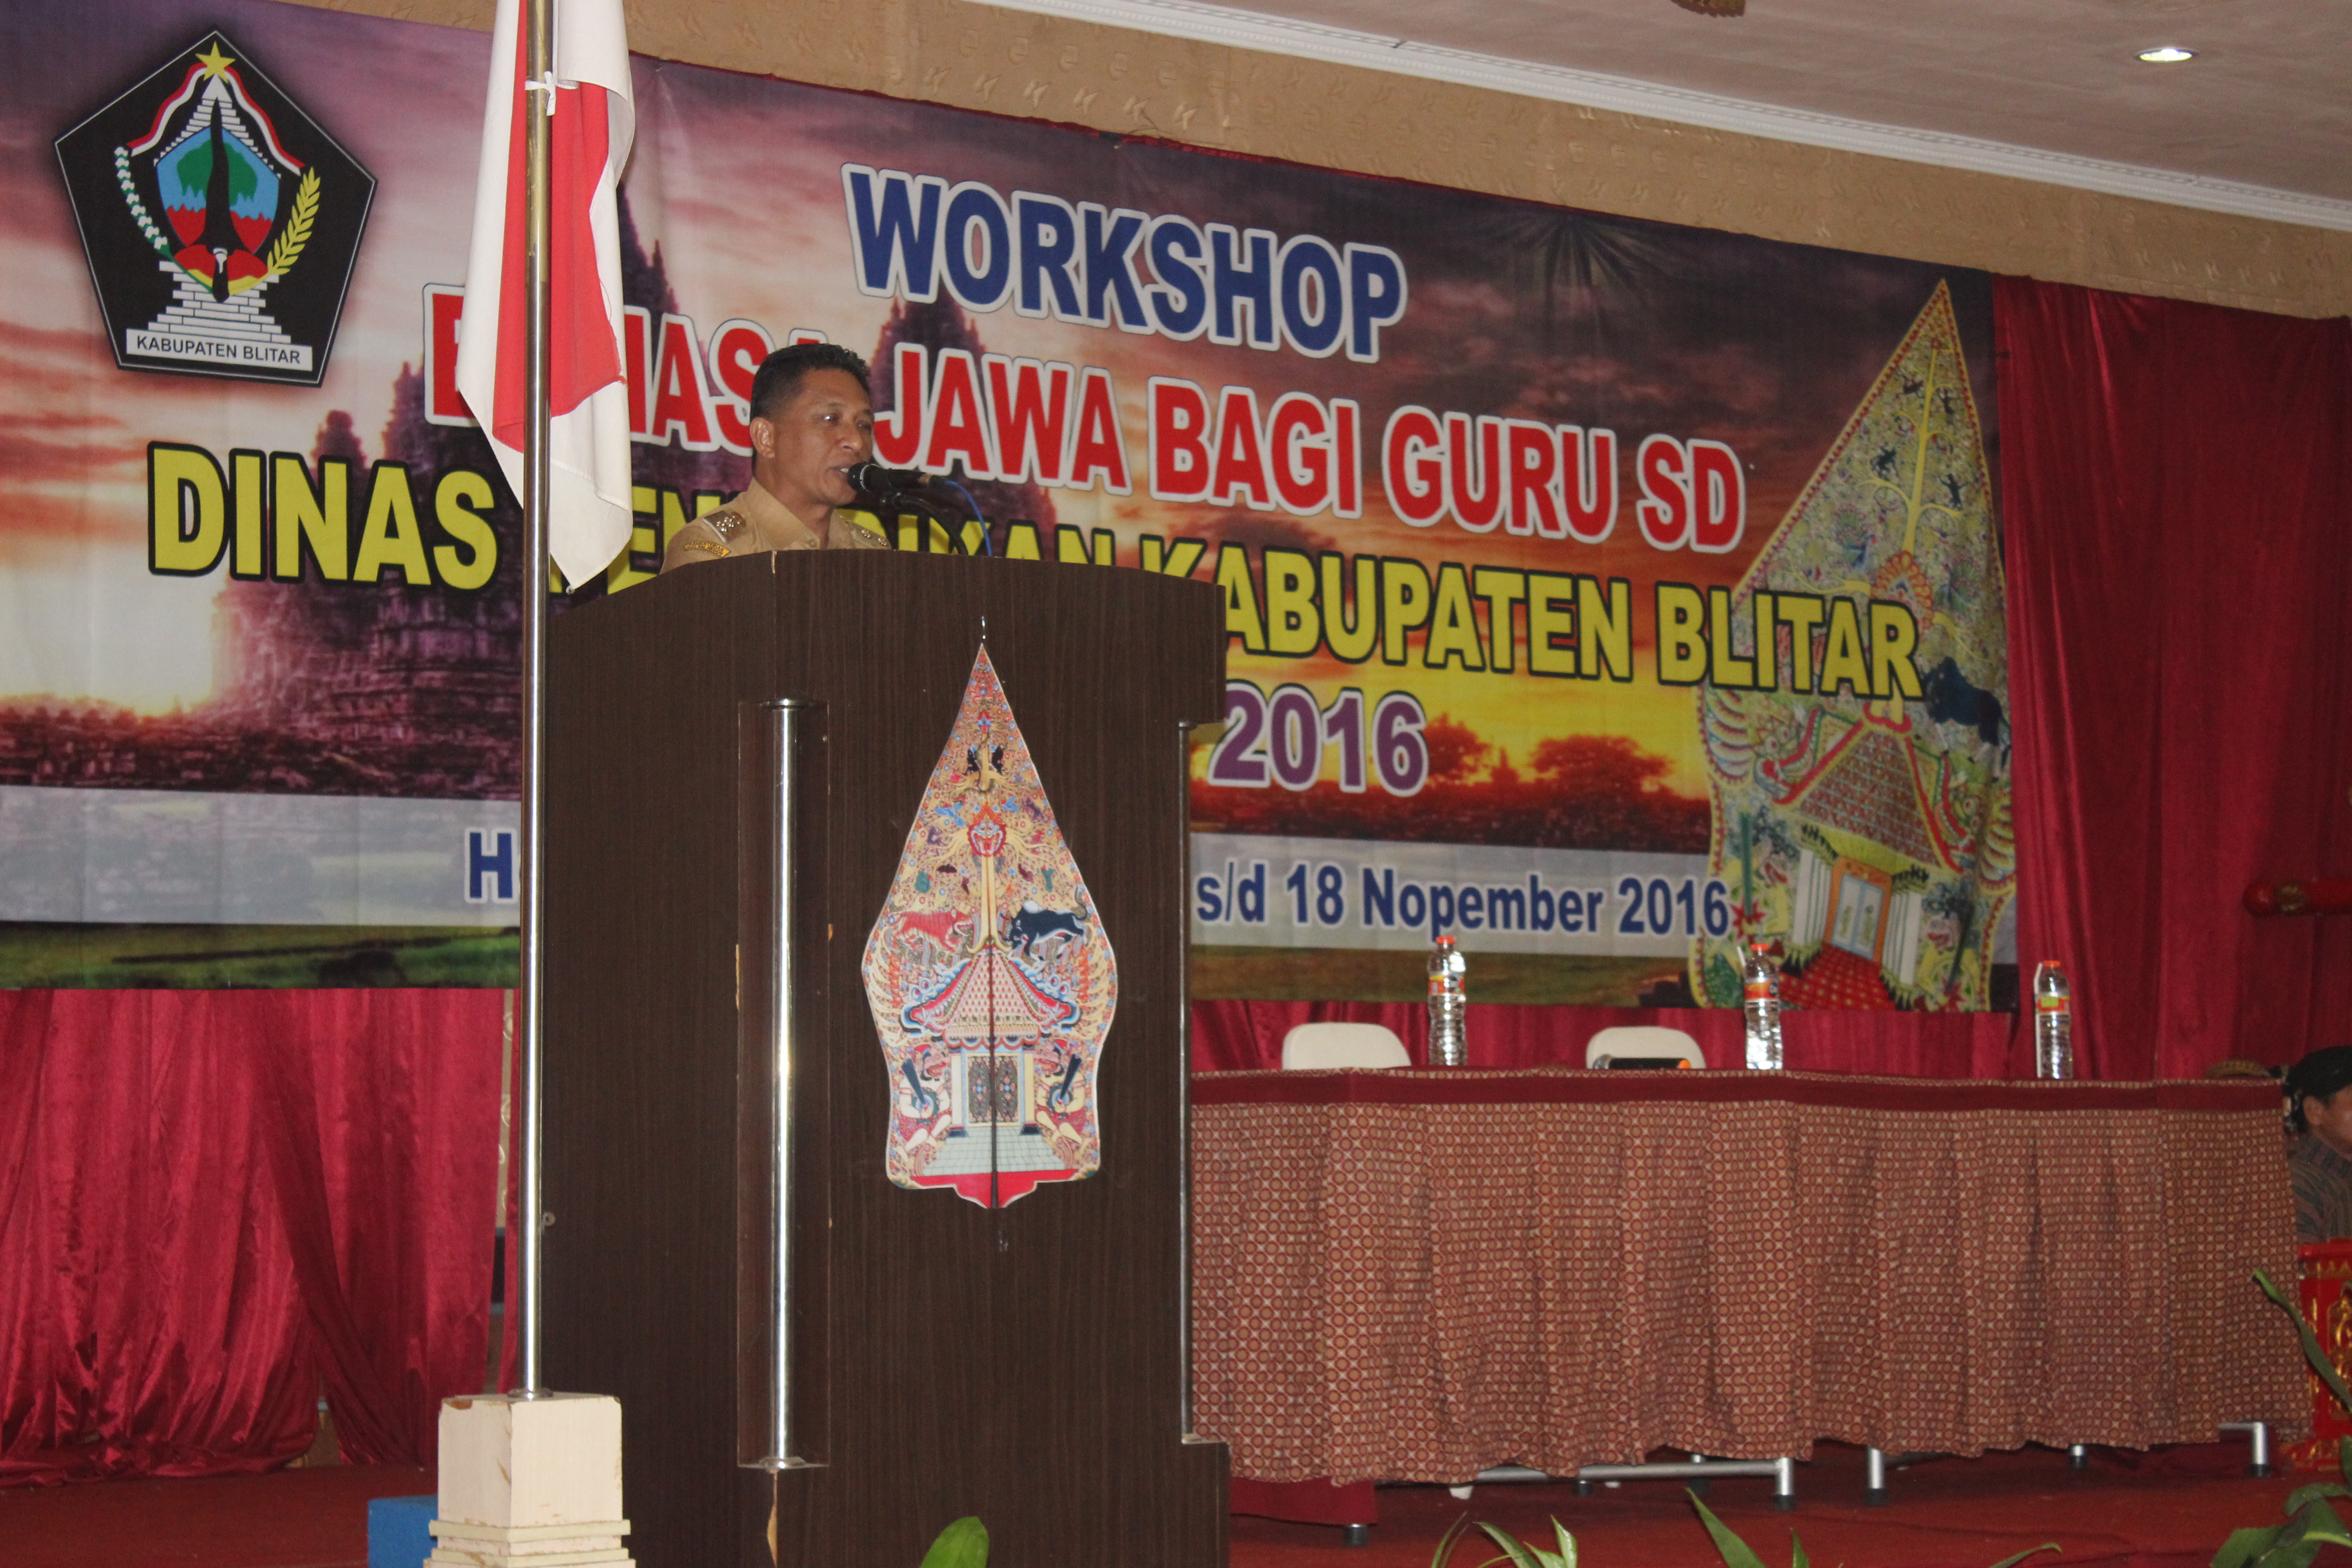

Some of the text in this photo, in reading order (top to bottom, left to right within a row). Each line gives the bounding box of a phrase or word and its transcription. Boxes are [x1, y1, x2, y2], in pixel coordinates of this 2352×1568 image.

[849, 171, 1401, 357] WORKSHOP
[137, 335, 300, 363] KABUPATEN BLITAR
[872, 348, 1127, 489] JAWA
[1154, 382, 1356, 513] BAGI
[1387, 411, 1613, 538] GURU
[1642, 439, 1741, 548] SD
[152, 446, 499, 592] DINAS
[1656, 584, 1924, 698] BLITAR
[1210, 687, 1425, 791] 2016
[1196, 862, 1266, 922] s/d
[1286, 864, 1345, 923] 18
[1362, 867, 1603, 943] Nopember
[1618, 878, 1730, 936] 2016
